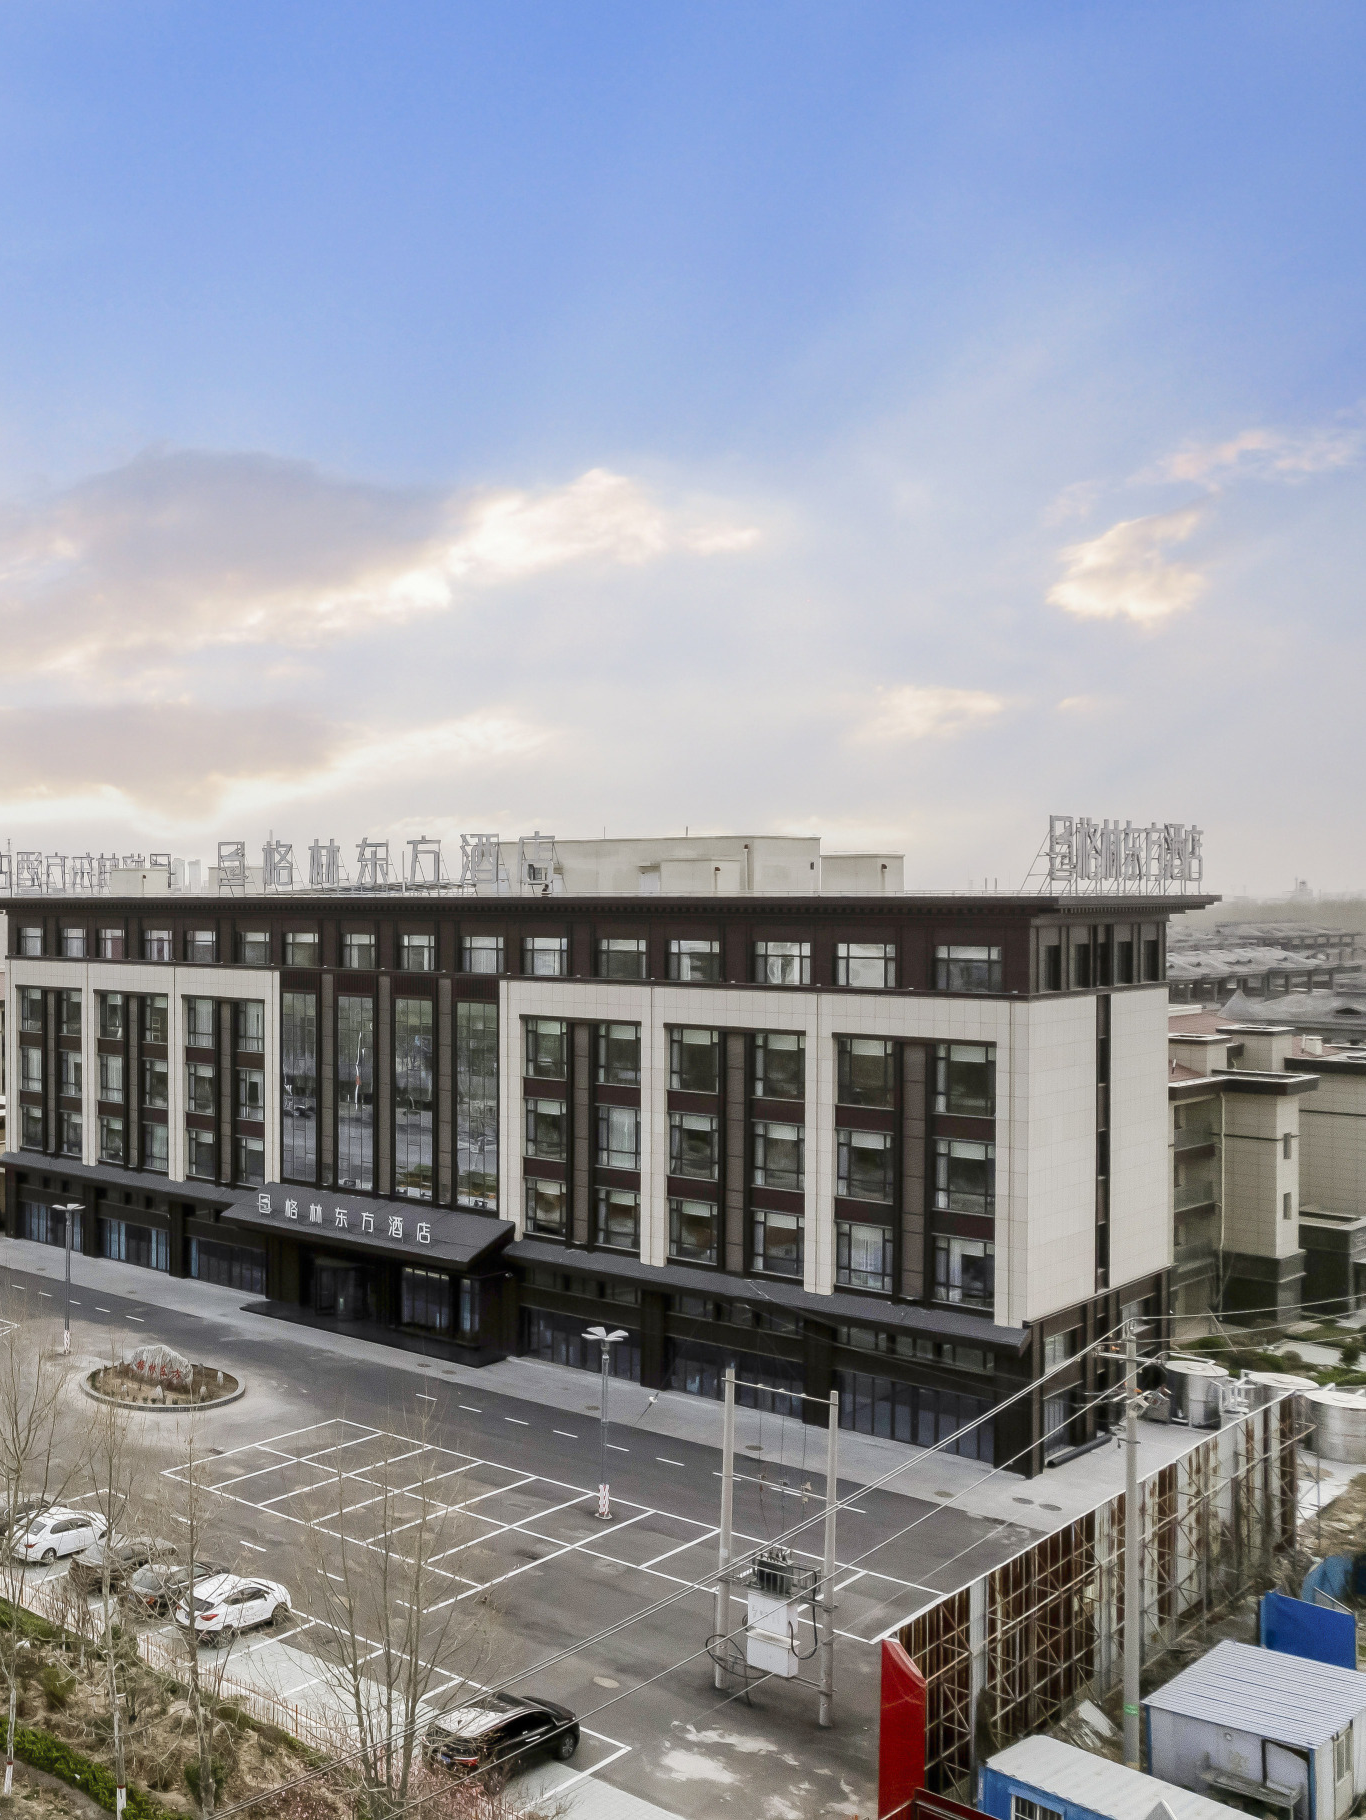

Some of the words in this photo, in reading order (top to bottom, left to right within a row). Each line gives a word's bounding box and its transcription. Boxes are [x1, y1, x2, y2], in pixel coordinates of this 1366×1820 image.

[262, 831, 556, 886] 格林东方酒店
[1076, 817, 1204, 881] 格林东方酒店
[285, 1198, 432, 1244] 格林东方酒店
